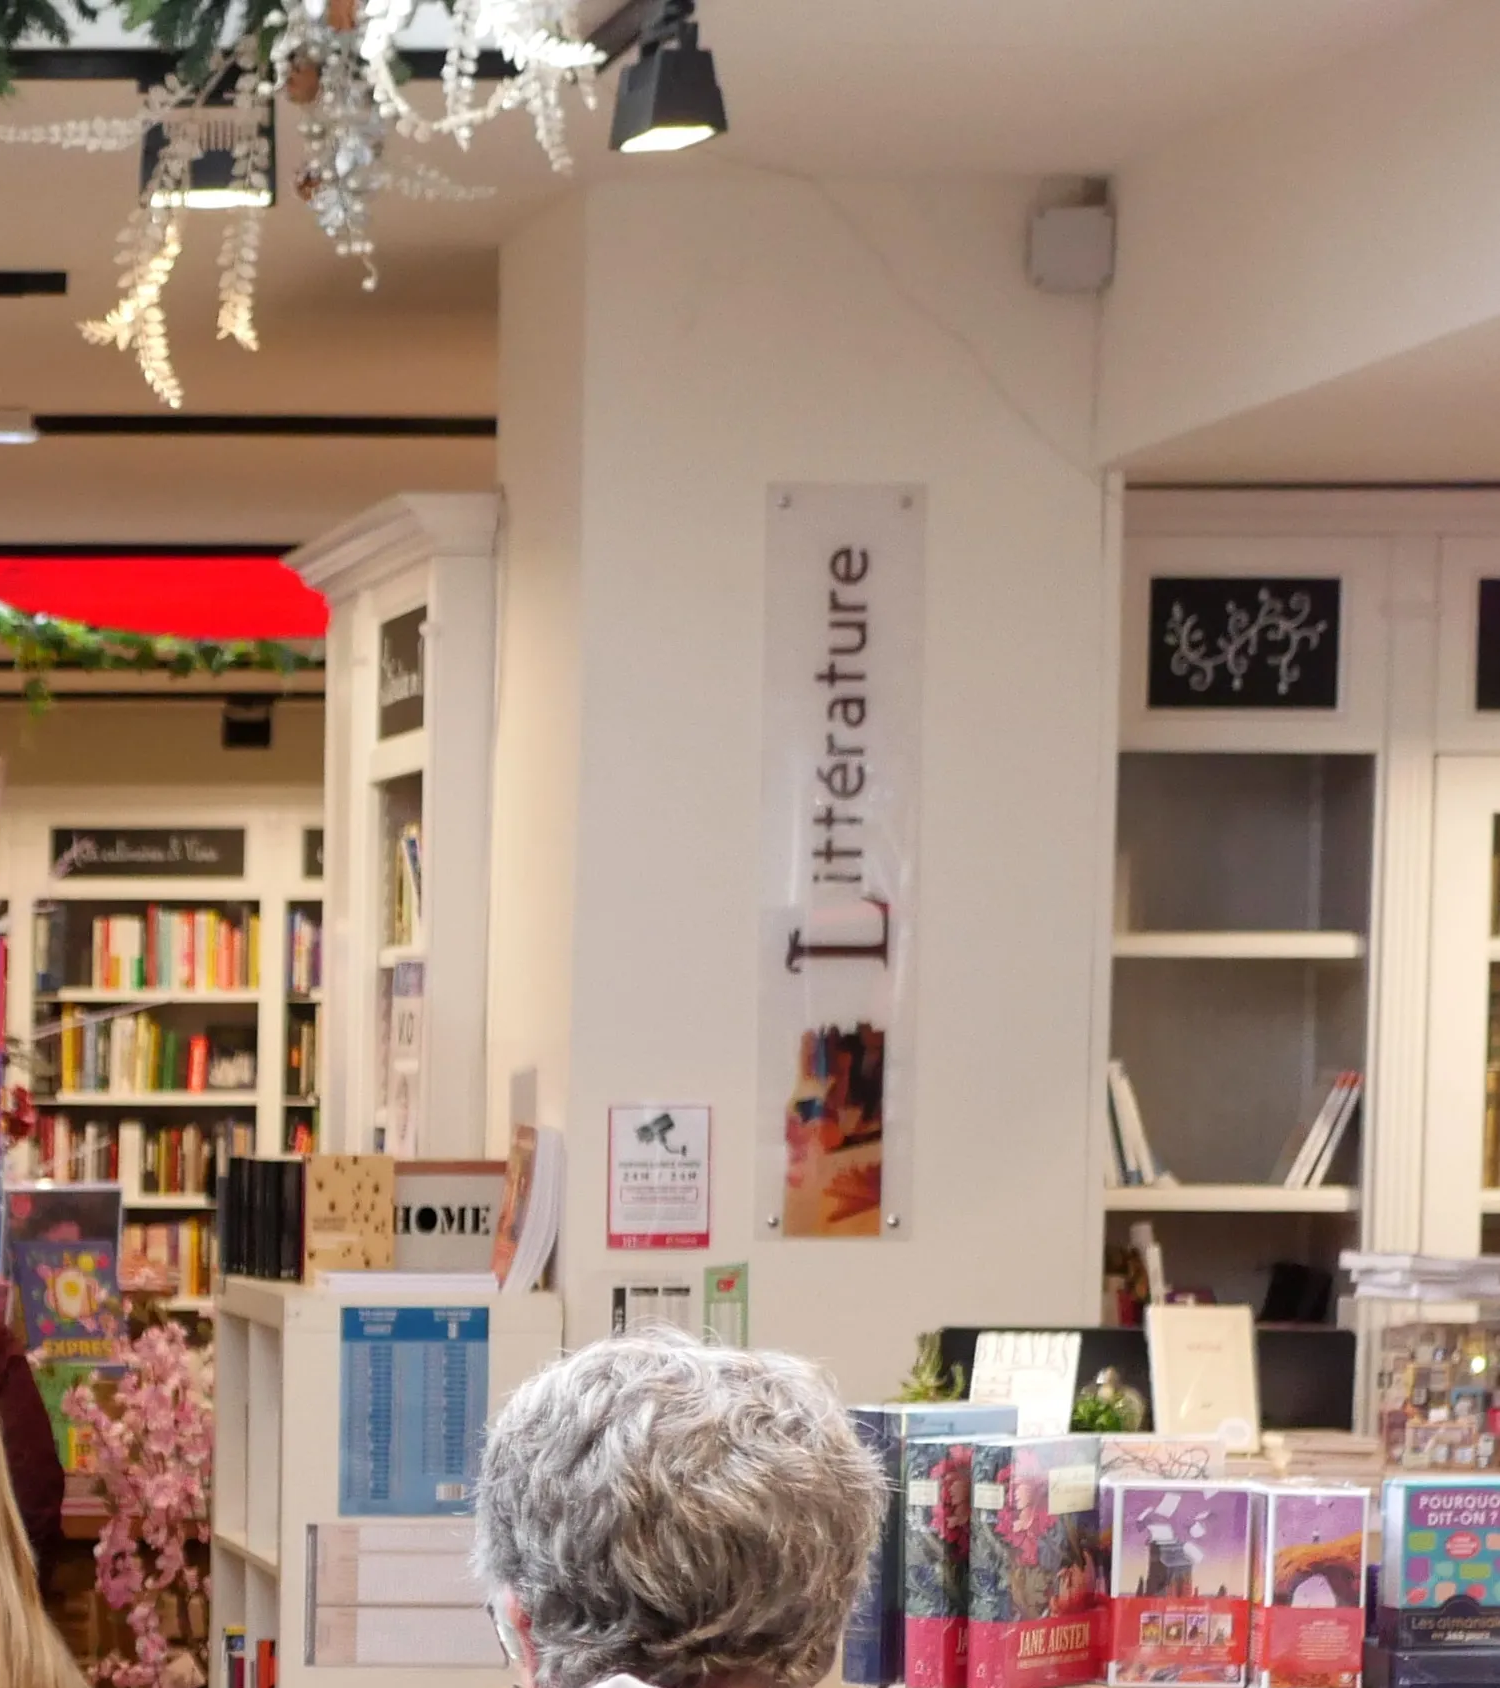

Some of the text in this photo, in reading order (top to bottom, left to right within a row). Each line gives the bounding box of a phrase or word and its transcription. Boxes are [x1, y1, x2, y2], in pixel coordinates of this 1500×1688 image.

[786, 543, 890, 975] Littérature
[392, 1203, 491, 1236] HOME
[1418, 1493, 1500, 1511] POURQUO
[1427, 1511, 1486, 1527] DIT-ON
[1017, 1621, 1092, 1658] JANE AUSTEN
